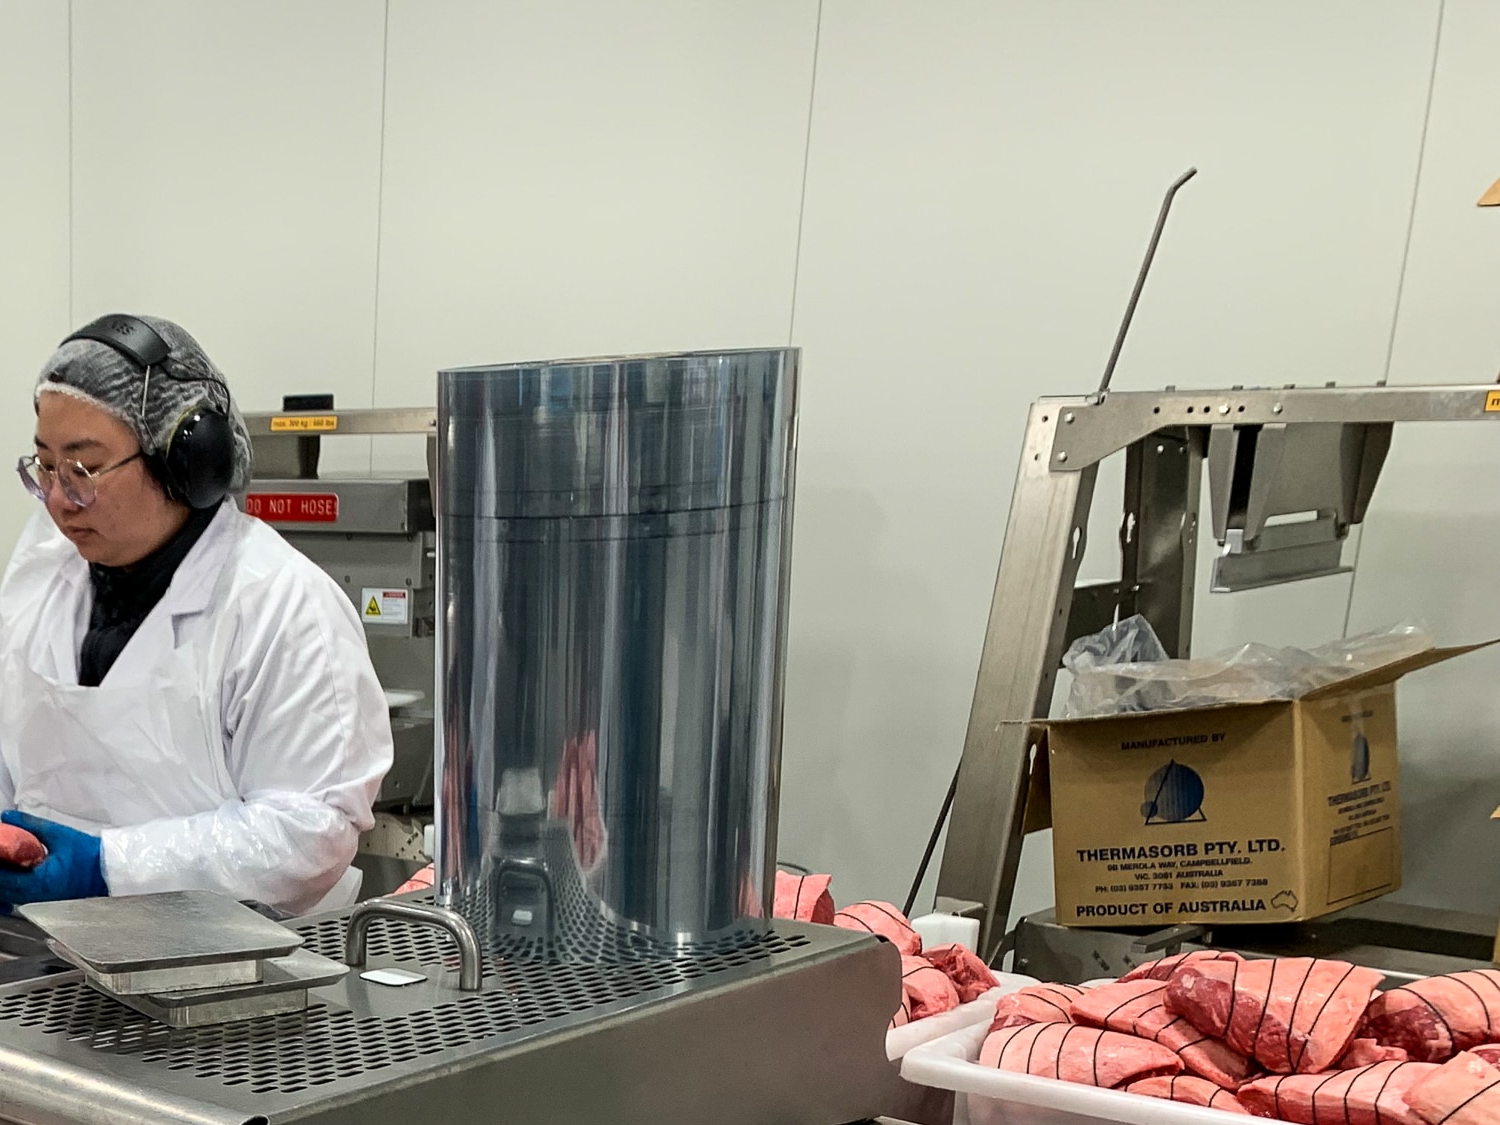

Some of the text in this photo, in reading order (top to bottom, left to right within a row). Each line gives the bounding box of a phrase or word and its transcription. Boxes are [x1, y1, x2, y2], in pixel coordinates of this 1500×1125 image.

[246, 498, 262, 514] DO
[269, 498, 292, 514] NOT
[1121, 732, 1226, 751] MANUFACTURED BY
[1076, 838, 1286, 863] THERMASORB PTY. LTD.
[1120, 861, 1156, 871] MEROLA
[1176, 869, 1223, 880] AUSTRALIA
[1076, 899, 1266, 918] PRODUCT OF AUSTRALIA
